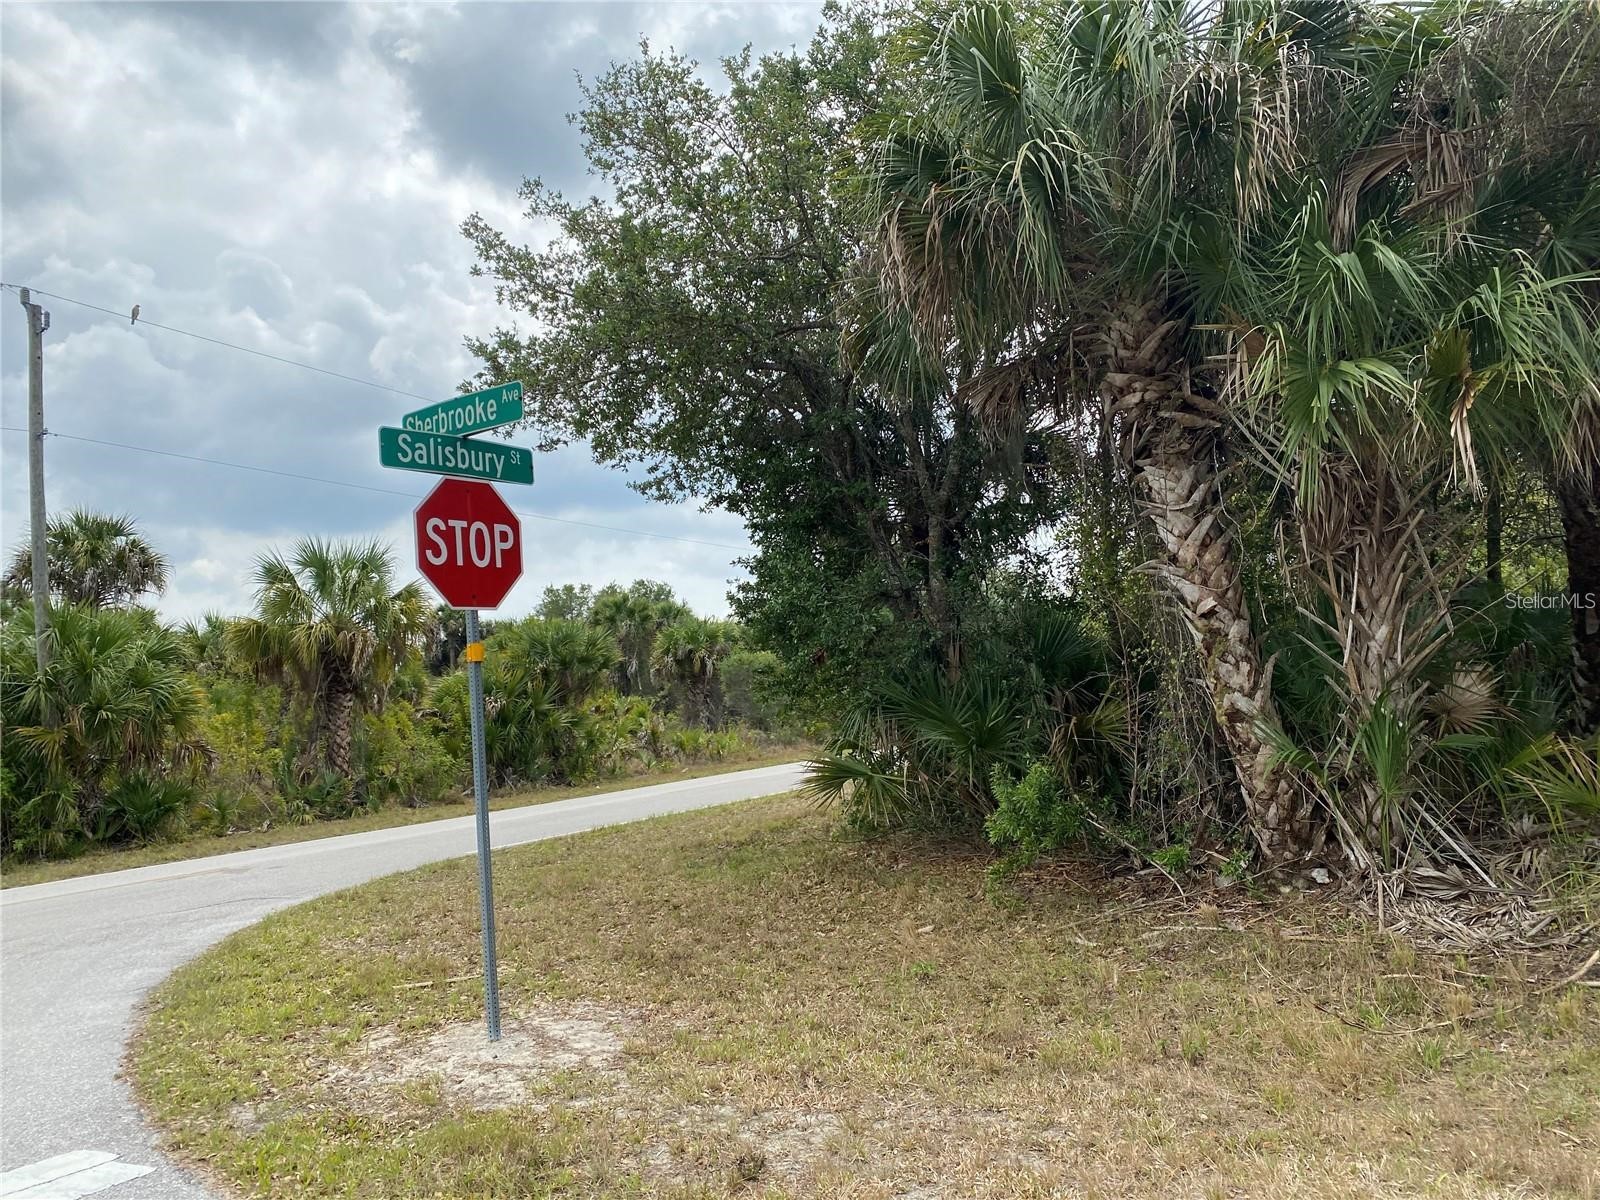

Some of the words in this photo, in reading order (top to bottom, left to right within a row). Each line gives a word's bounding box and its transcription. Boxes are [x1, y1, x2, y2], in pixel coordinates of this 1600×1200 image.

[406, 397, 497, 433] Sherbrooke
[502, 389, 519, 404] Ave
[397, 433, 505, 479] Salisbury
[510, 450, 521, 465] St
[425, 517, 514, 569] STOP
